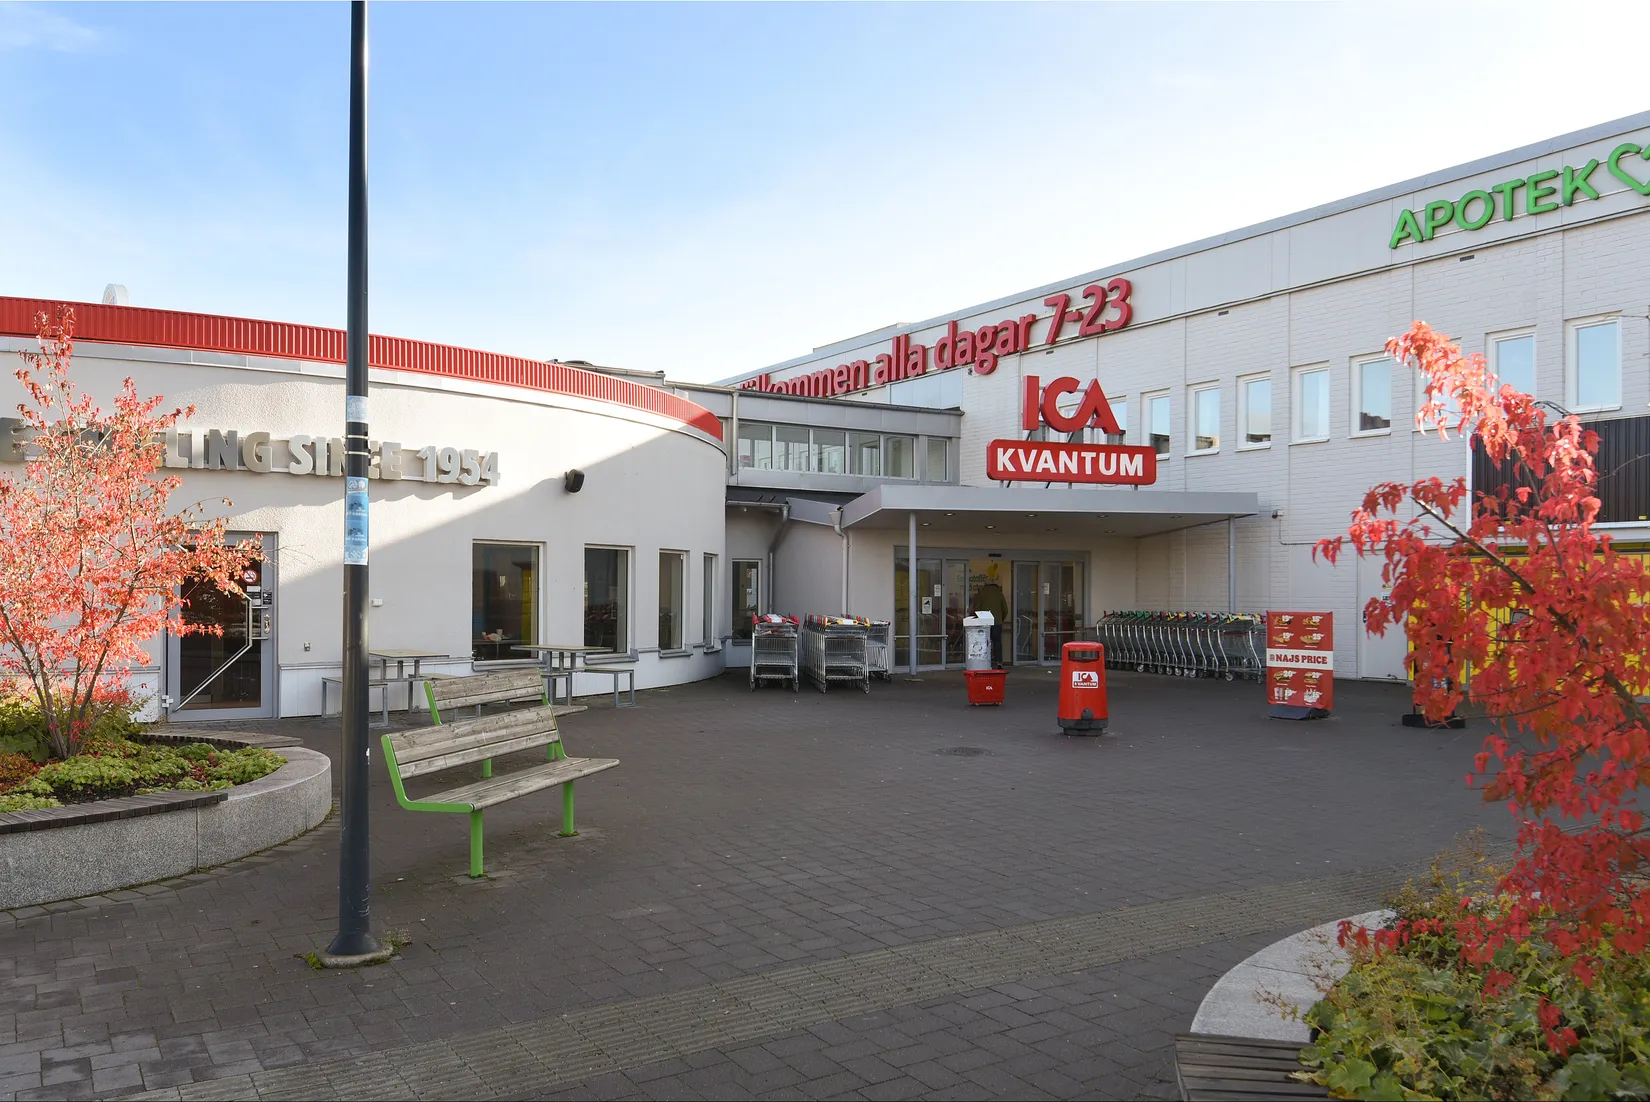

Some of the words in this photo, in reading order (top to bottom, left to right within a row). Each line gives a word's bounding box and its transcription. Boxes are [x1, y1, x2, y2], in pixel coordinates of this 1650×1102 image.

[1389, 159, 1600, 250] APOTEK
[874, 334, 927, 384] alla
[934, 320, 1036, 376] dagar
[1044, 277, 1133, 345] 7-23
[1022, 375, 1123, 435] ICA
[416, 445, 501, 487] 1954
[997, 447, 1145, 478] KVANTUM
[1078, 672, 1093, 682] ICA
[1276, 655, 1300, 663] NAJS
[1302, 656, 1328, 664] PRICE
